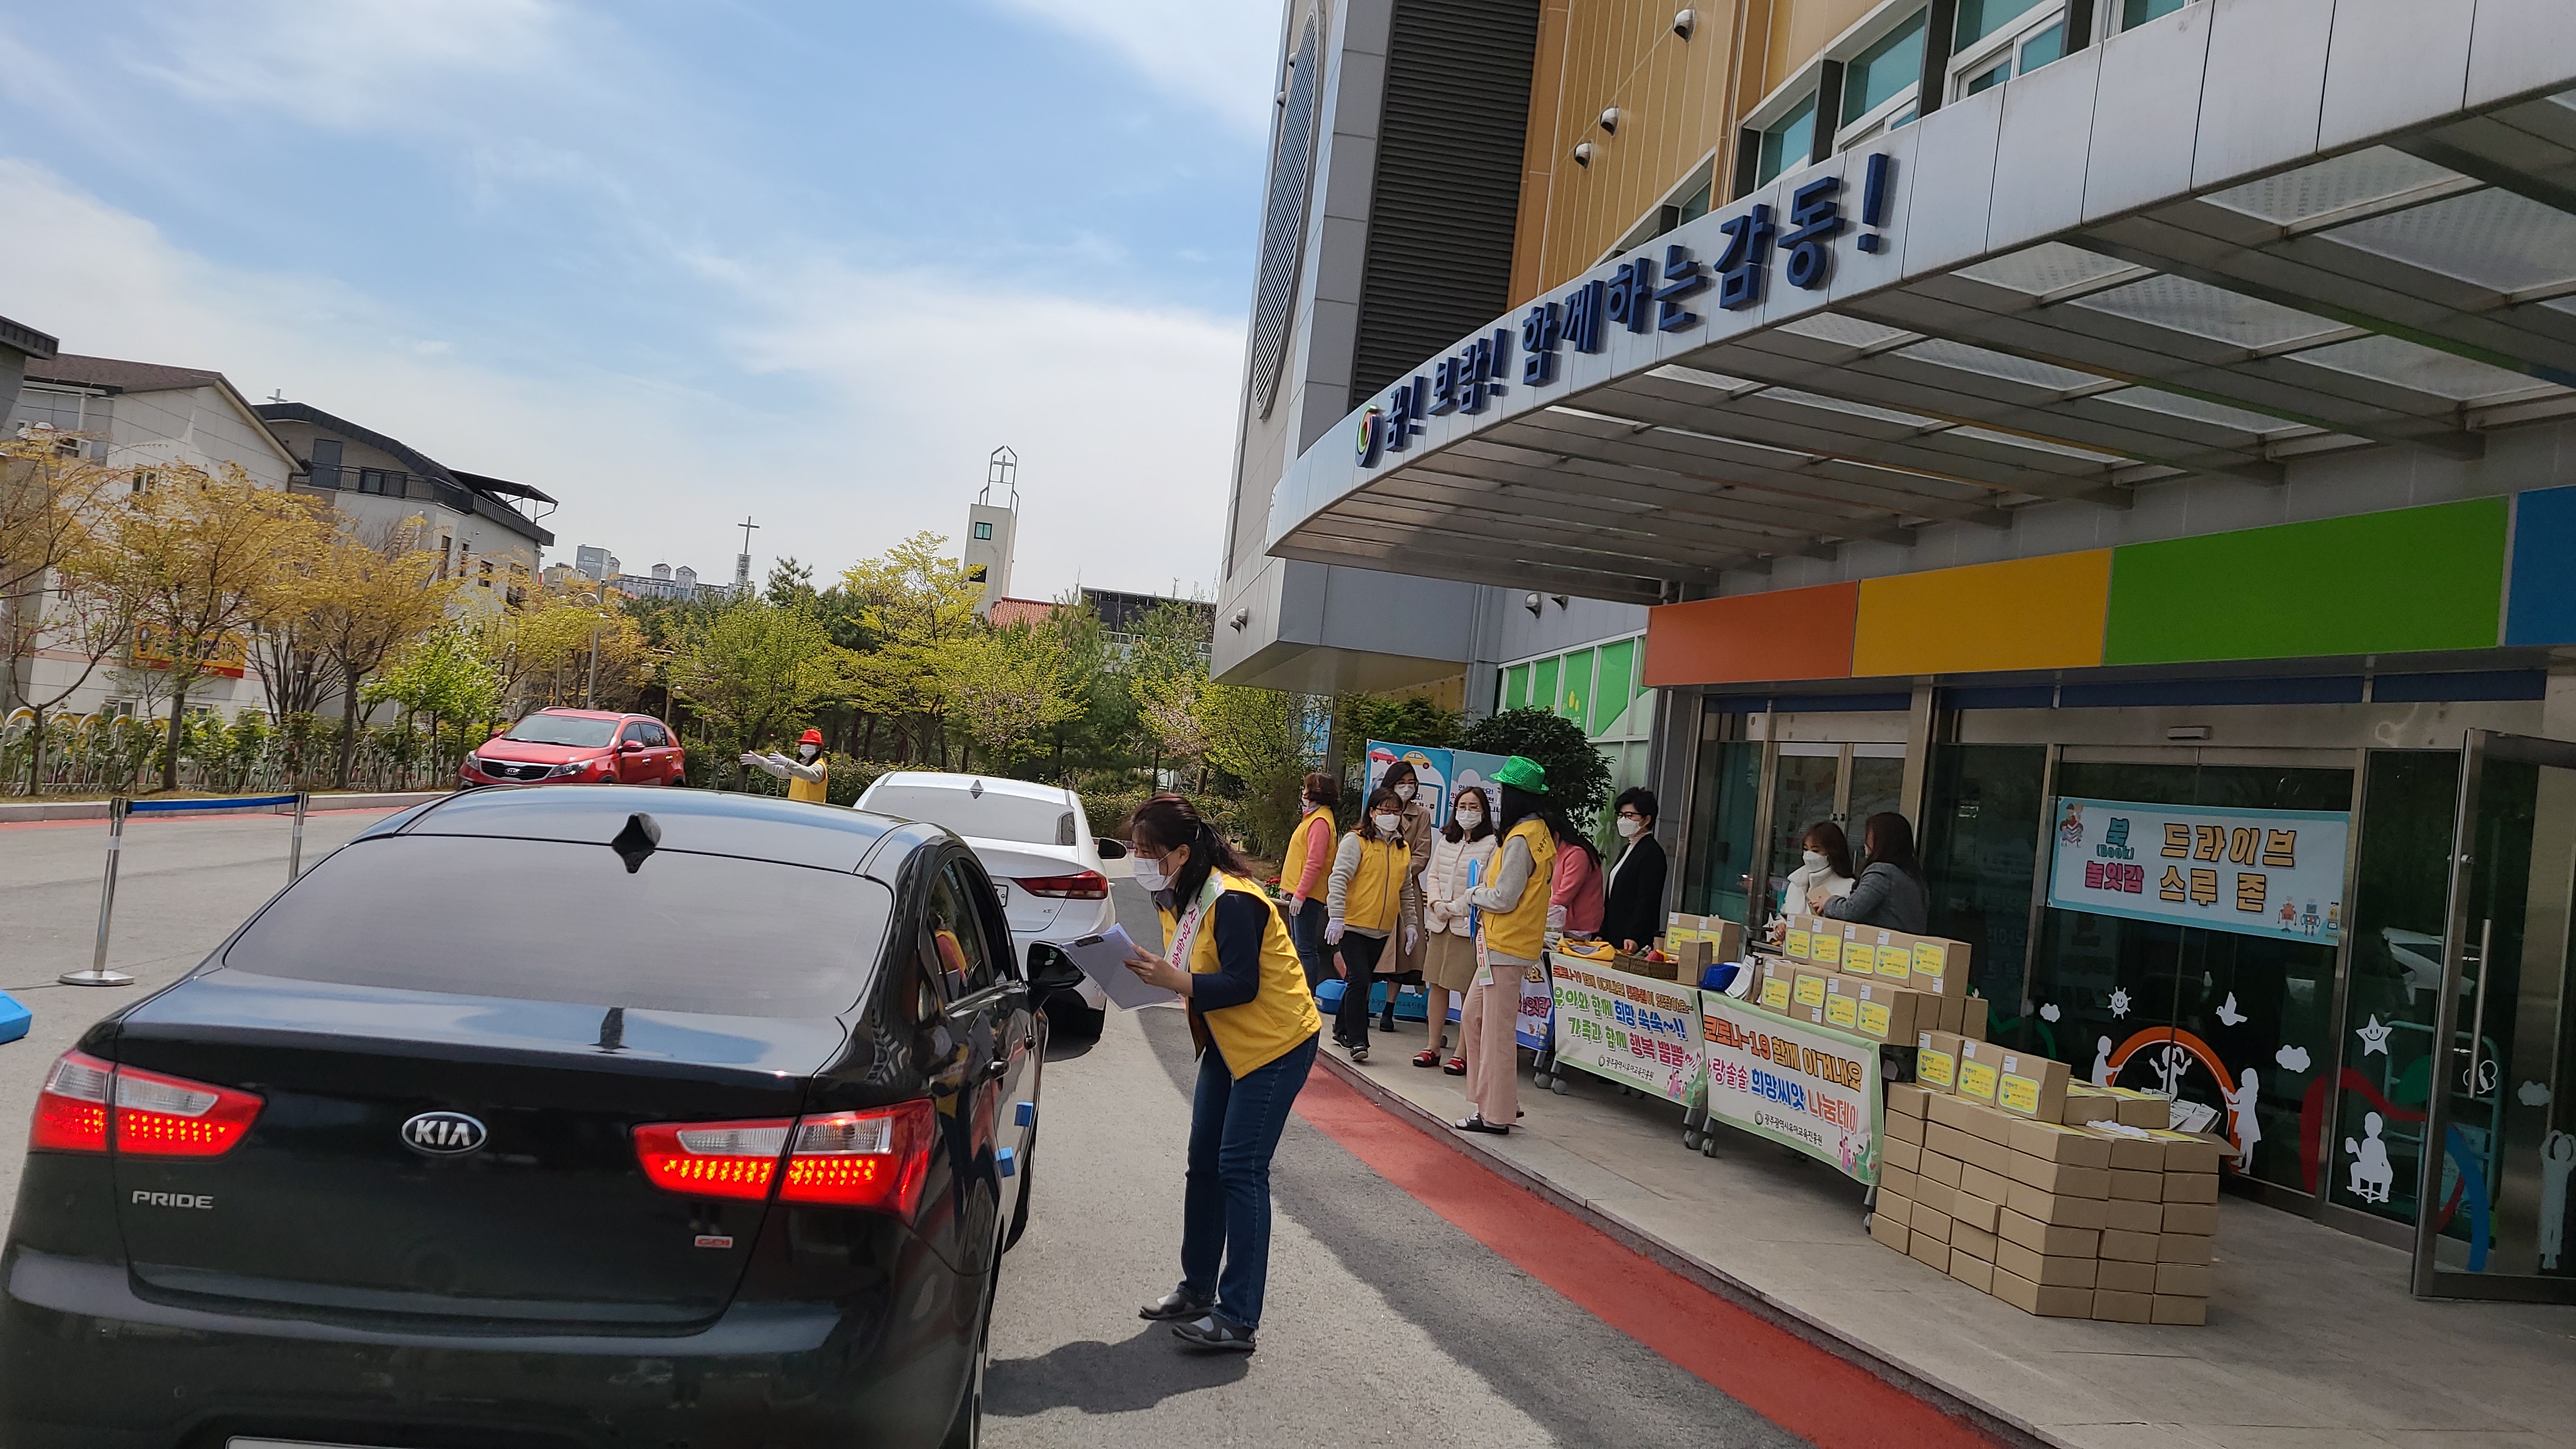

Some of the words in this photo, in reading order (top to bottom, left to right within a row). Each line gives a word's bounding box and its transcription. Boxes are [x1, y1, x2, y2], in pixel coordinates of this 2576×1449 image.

[1385, 376, 1426, 452] 꿈!
[1427, 328, 1508, 418] 보람!
[1714, 152, 1890, 310] 감동!
[2096, 844, 2135, 860] (Book)
[2106, 817, 2129, 847] 북
[2161, 823, 2297, 868] 드라이브
[2085, 860, 2144, 894] 놀잇감
[2159, 865, 2218, 907] 스루
[2236, 872, 2266, 912] 존
[1552, 964, 1582, 983] 코로나-19
[1581, 972, 1597, 989] 함께
[1554, 986, 1588, 1009] 유아와
[1591, 993, 1613, 1018] 함께
[1614, 999, 1636, 1027] 희망
[1568, 1017, 1602, 1041] 가족과
[1605, 1025, 1627, 1050] 함께
[1629, 1032, 1656, 1059] 행복
[1704, 1014, 1771, 1061] 코로나-19
[1771, 1036, 1802, 1071] 함께
[1802, 1047, 1863, 1093] 이겨내요
[1751, 1068, 1805, 1111] 희망씨앗
[1807, 1088, 1858, 1136] 나눔데이
[415, 1119, 471, 1146] KIA
[1765, 1114, 1823, 1147] 광주광역시유아교육진흥원
[132, 1190, 214, 1209] PRIDE
